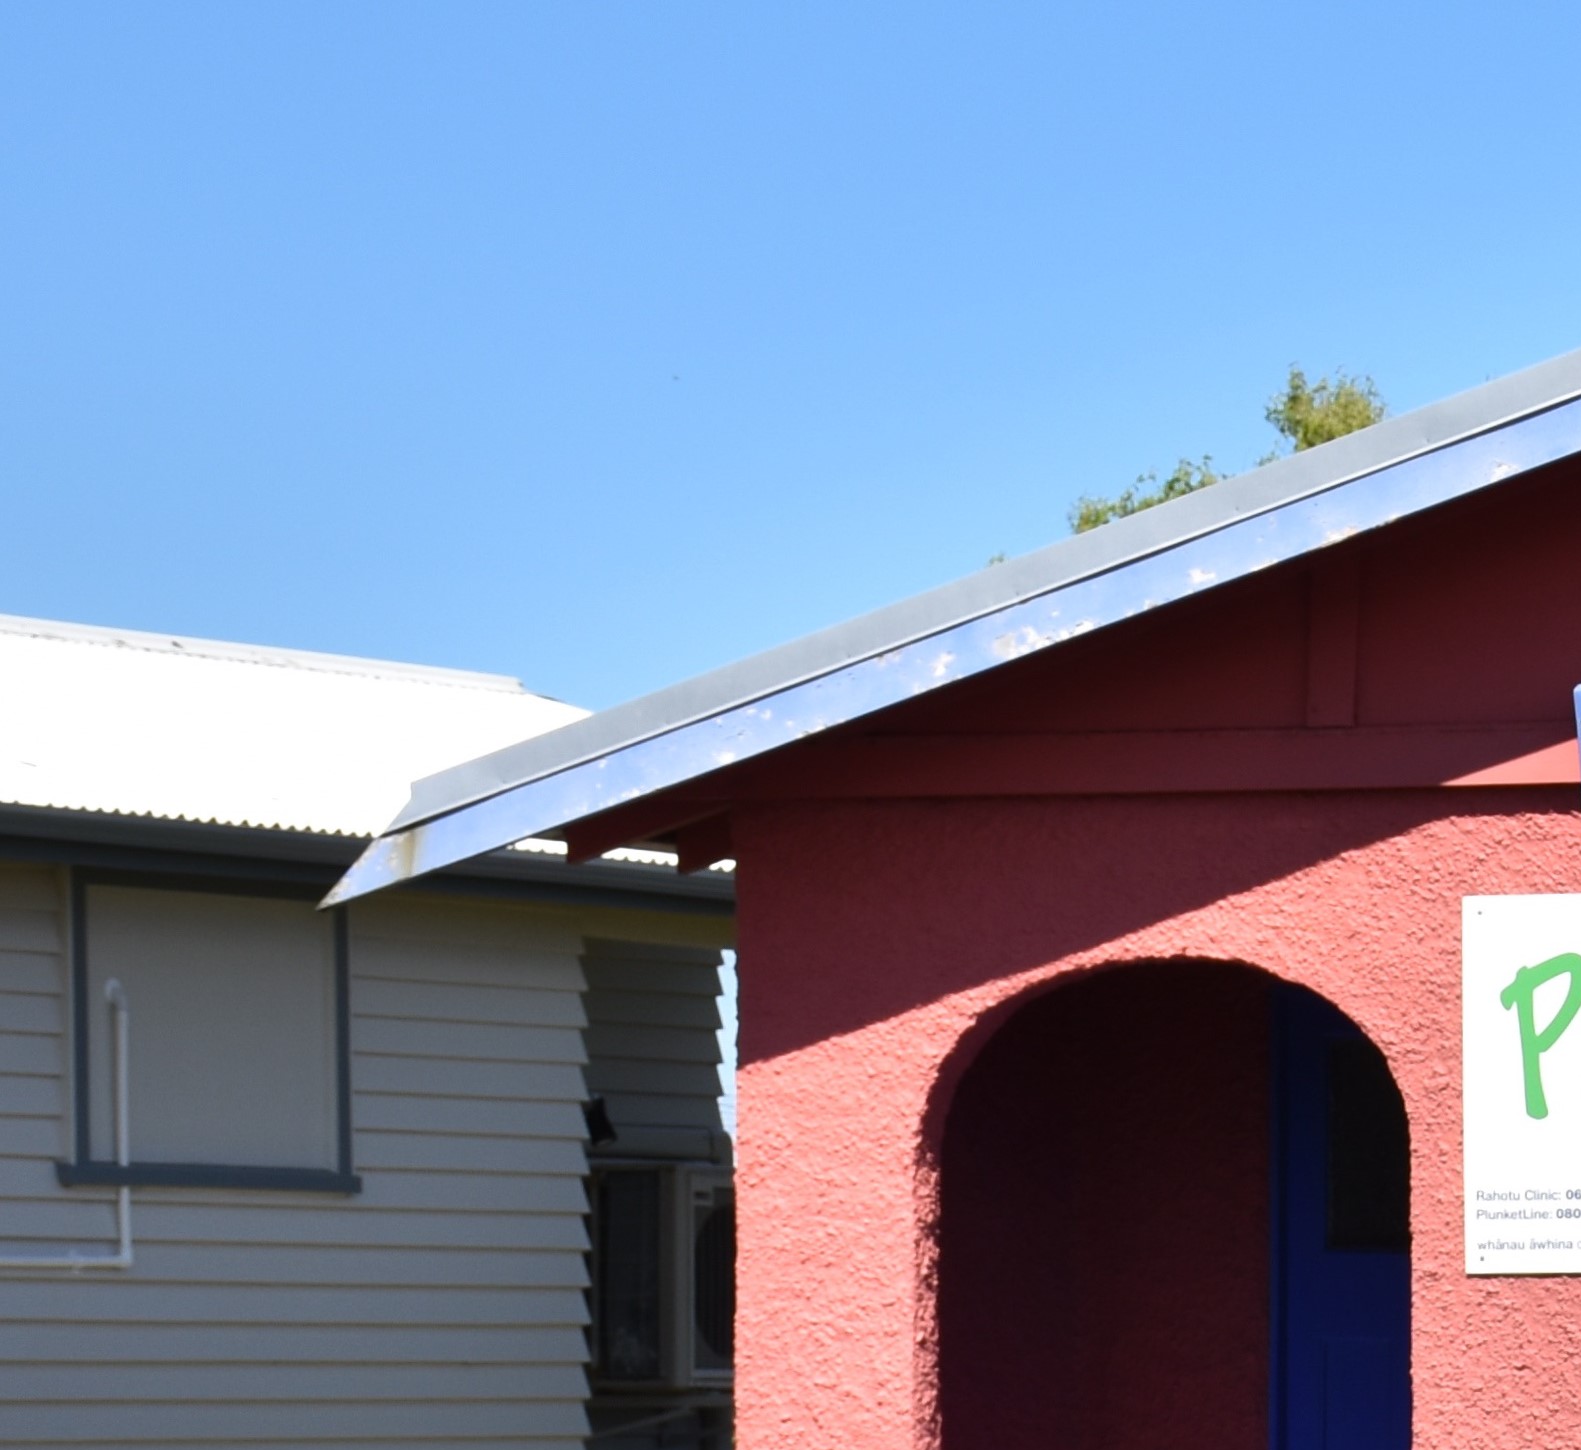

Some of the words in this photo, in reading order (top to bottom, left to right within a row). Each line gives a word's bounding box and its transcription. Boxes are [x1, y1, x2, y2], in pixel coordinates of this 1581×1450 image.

[1476, 1189, 1520, 1201] Rahotu
[1524, 1189, 1562, 1201] Clinic:
[1476, 1208, 1553, 1220] PlunketLine:
